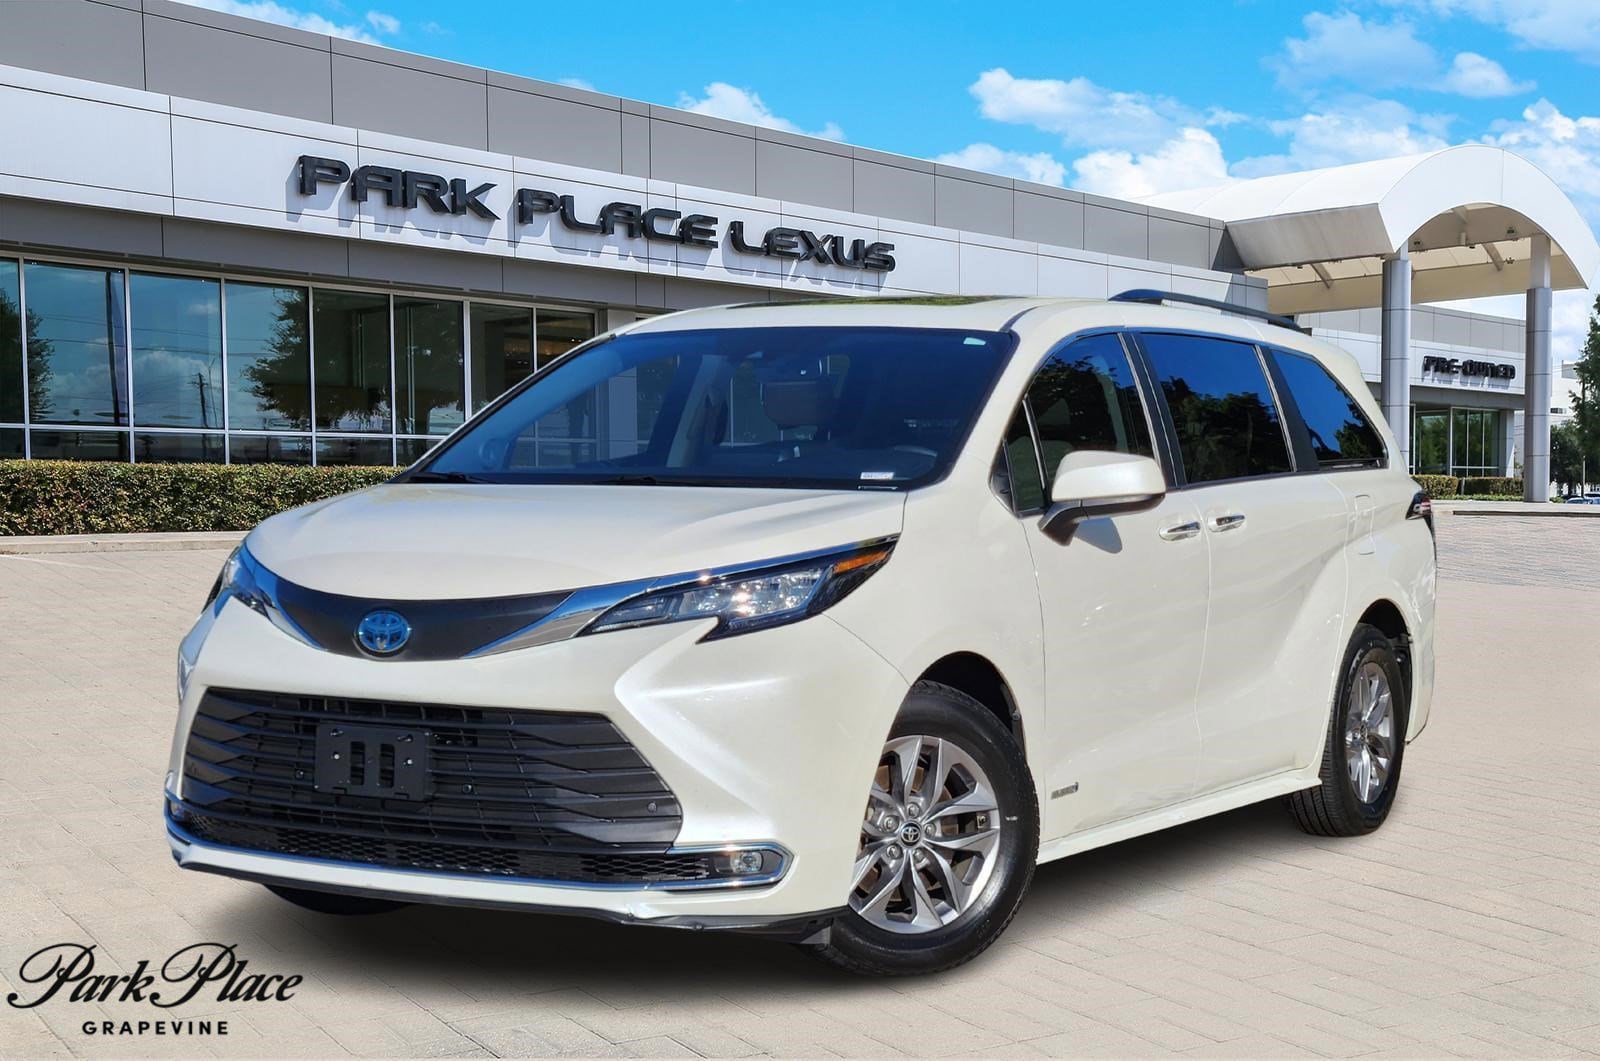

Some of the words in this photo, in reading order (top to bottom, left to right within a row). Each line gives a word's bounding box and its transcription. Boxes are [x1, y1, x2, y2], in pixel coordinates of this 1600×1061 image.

[298, 154, 500, 220] PARK
[517, 187, 718, 249] PLACE
[730, 220, 896, 272] LEXUS
[1423, 356, 1515, 379] PRE-OWNED
